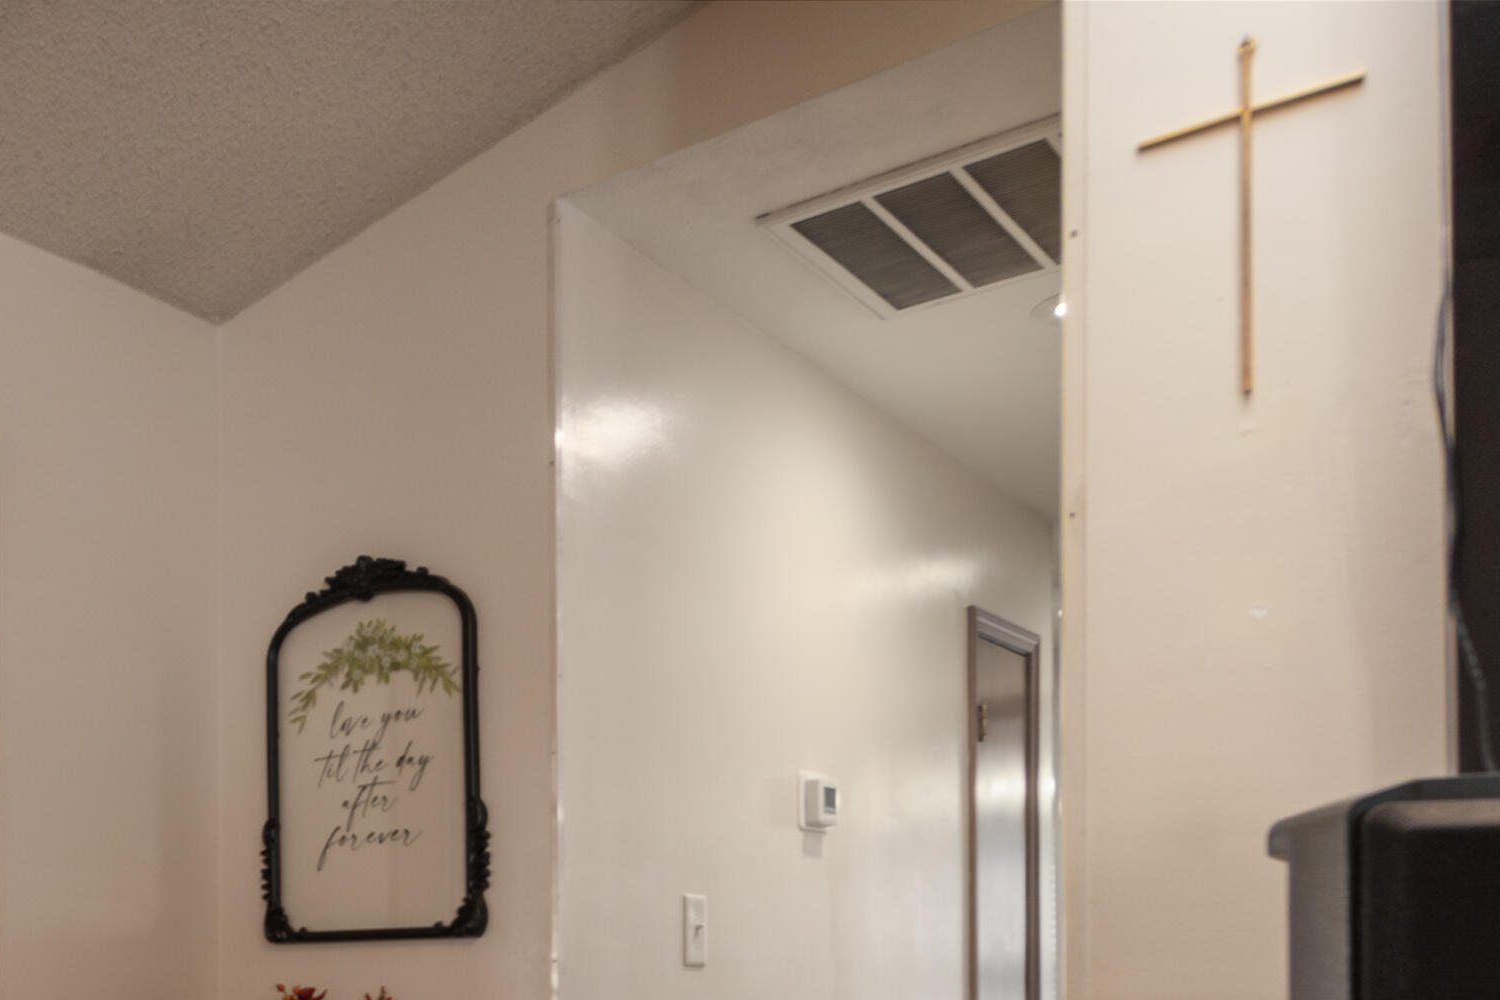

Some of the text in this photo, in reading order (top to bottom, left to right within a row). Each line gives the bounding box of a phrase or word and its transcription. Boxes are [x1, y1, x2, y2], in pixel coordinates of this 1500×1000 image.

[329, 700, 426, 750] love you
[353, 739, 388, 784] the
[395, 740, 434, 792] day
[341, 775, 398, 832] after
[316, 825, 426, 872] forever
